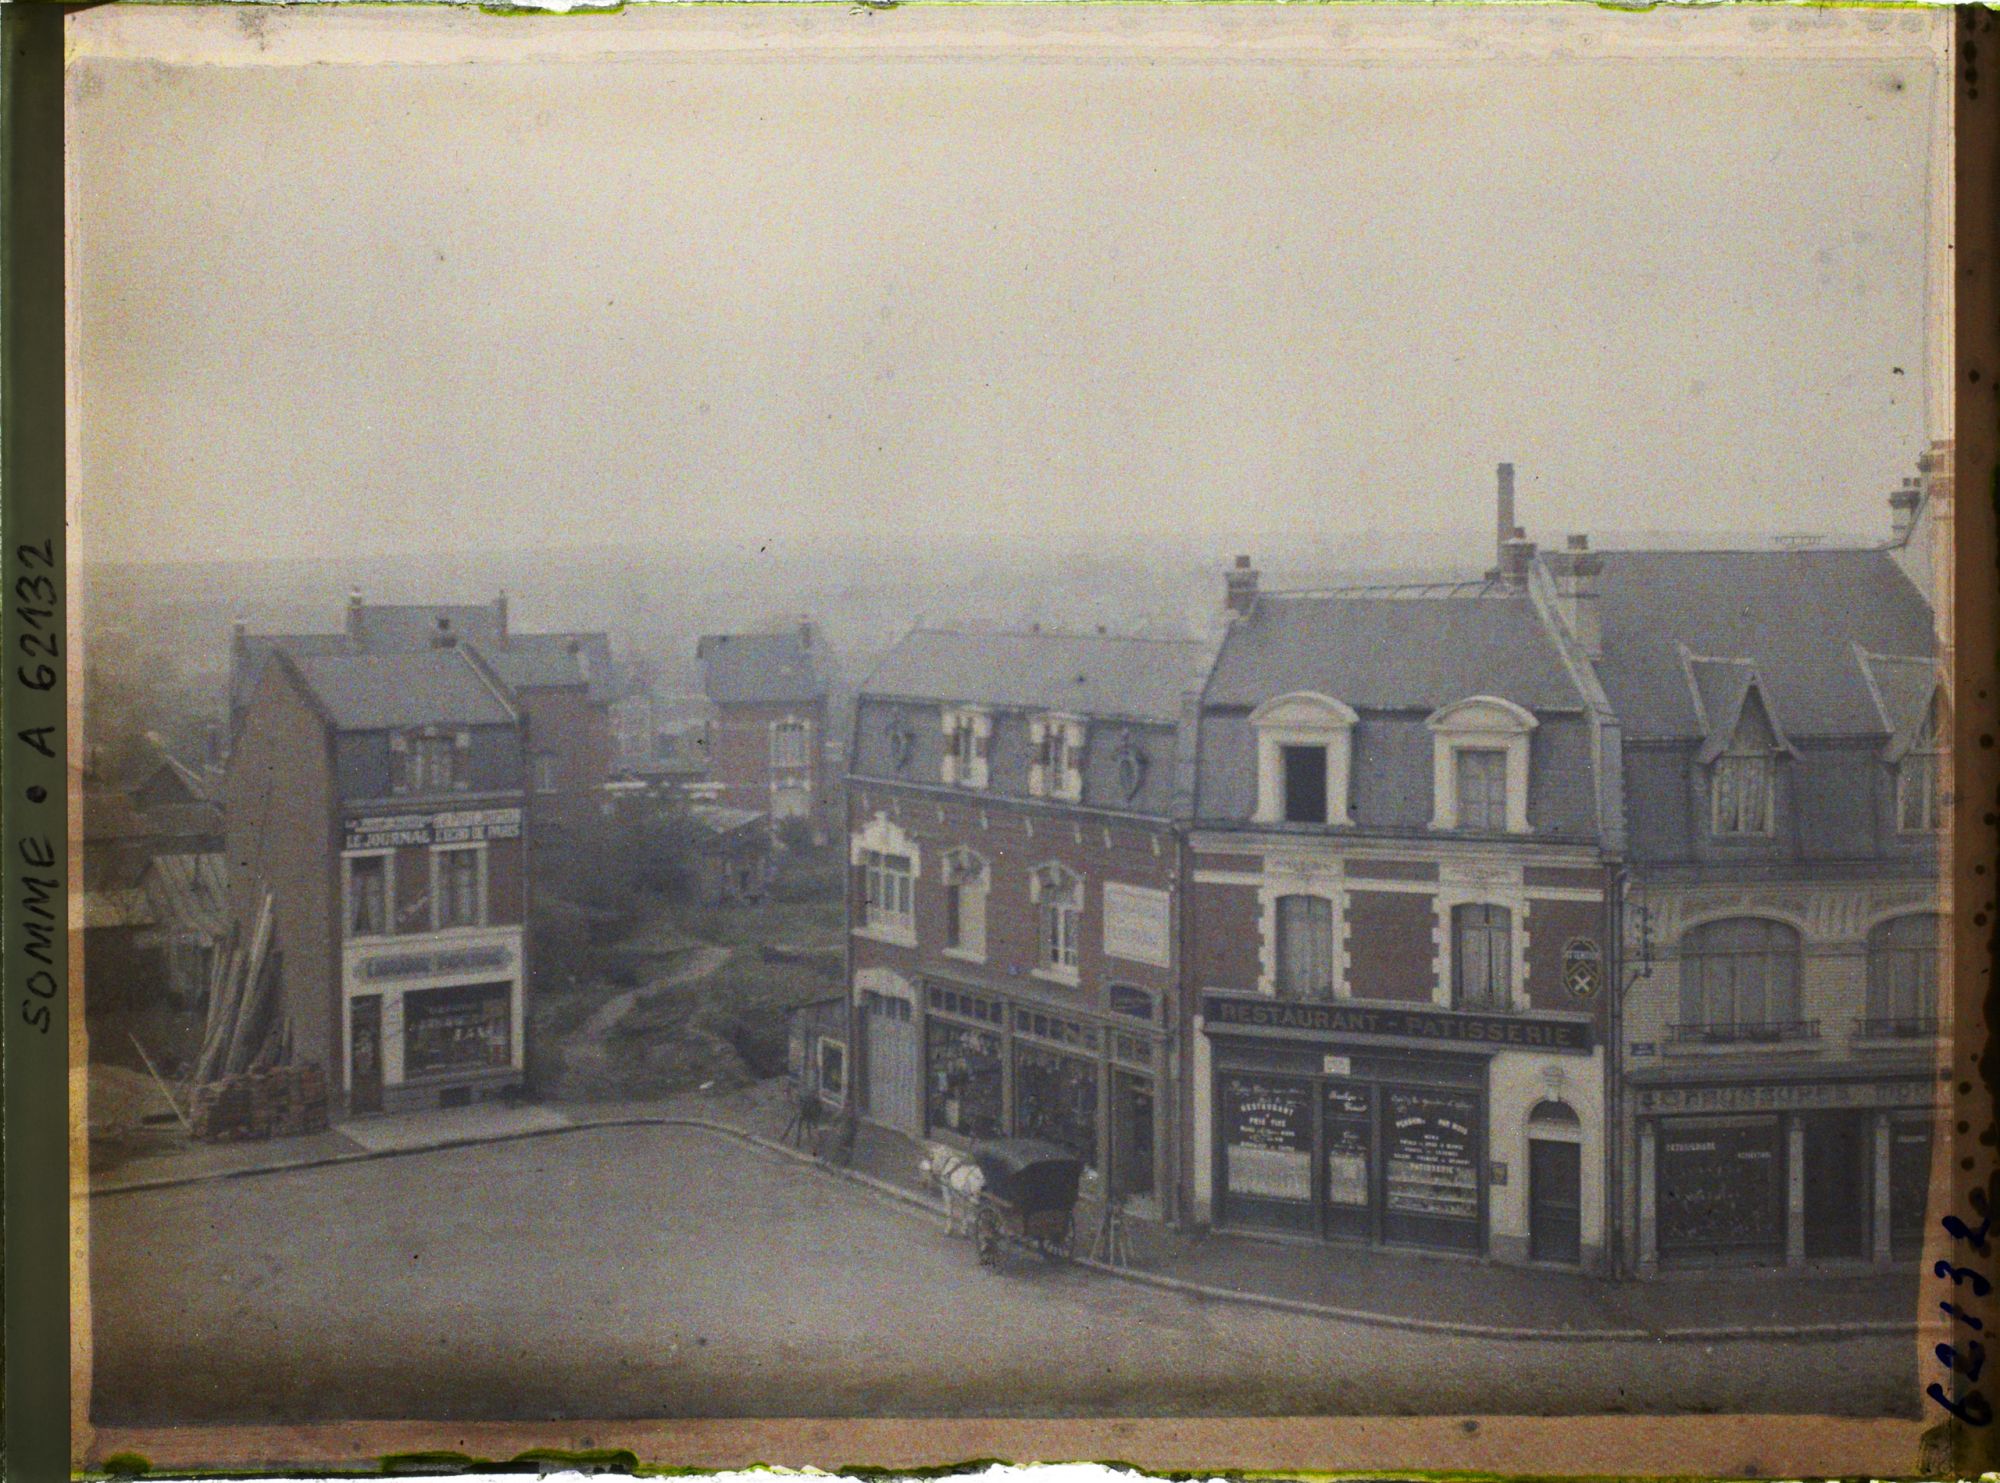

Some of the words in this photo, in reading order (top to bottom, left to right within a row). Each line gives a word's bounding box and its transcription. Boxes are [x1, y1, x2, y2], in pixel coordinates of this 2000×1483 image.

[16, 539, 58, 691] 62132
[19, 725, 56, 759] A
[364, 830, 431, 848] JOURNAL
[20, 837, 59, 1035] SOMME
[1219, 1003, 1381, 1033] RESTAURANT
[1404, 1016, 1573, 1046] PATISSERIE
[1926, 1213, 1993, 1427] 62132
